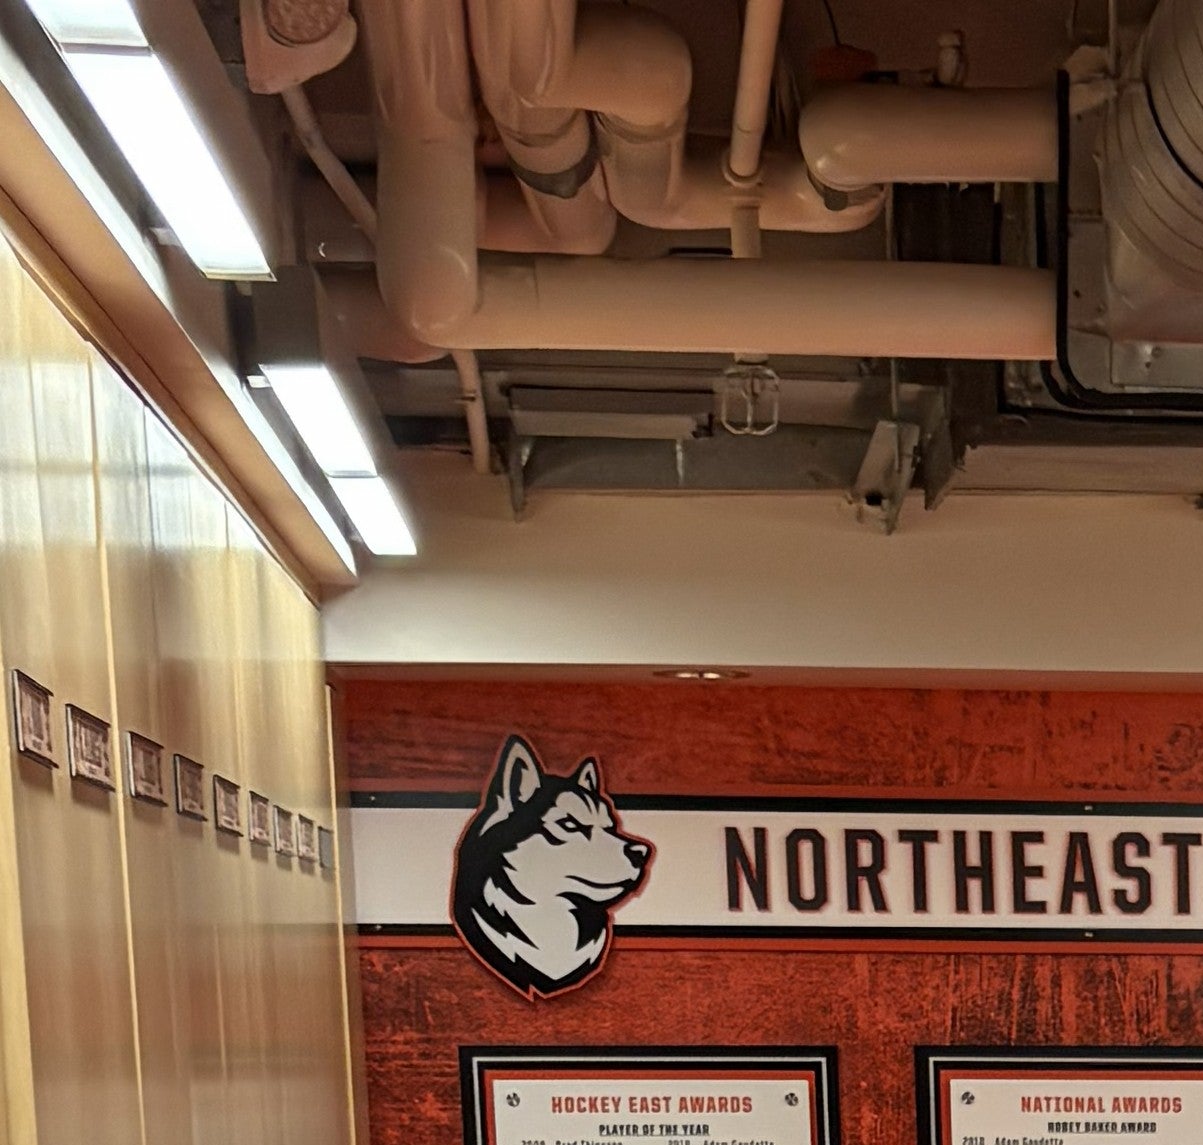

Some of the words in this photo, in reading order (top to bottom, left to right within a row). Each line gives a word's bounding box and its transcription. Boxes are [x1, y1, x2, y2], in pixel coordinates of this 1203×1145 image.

[551, 1096, 621, 1113] HOCKEY
[628, 1096, 671, 1113] EAST
[678, 1096, 752, 1113] AWARDS
[1020, 1096, 1105, 1112] NATIONAL
[1111, 1096, 1182, 1113] AWARDS
[598, 1124, 639, 1136] PLAYER
[641, 1124, 655, 1136] OF
[658, 1124, 678, 1136] THE
[681, 1124, 709, 1136] YEAR
[1047, 1121, 1081, 1133] HOBEY
[1084, 1122, 1118, 1133] BAKER
[1120, 1122, 1157, 1133] AWARD
